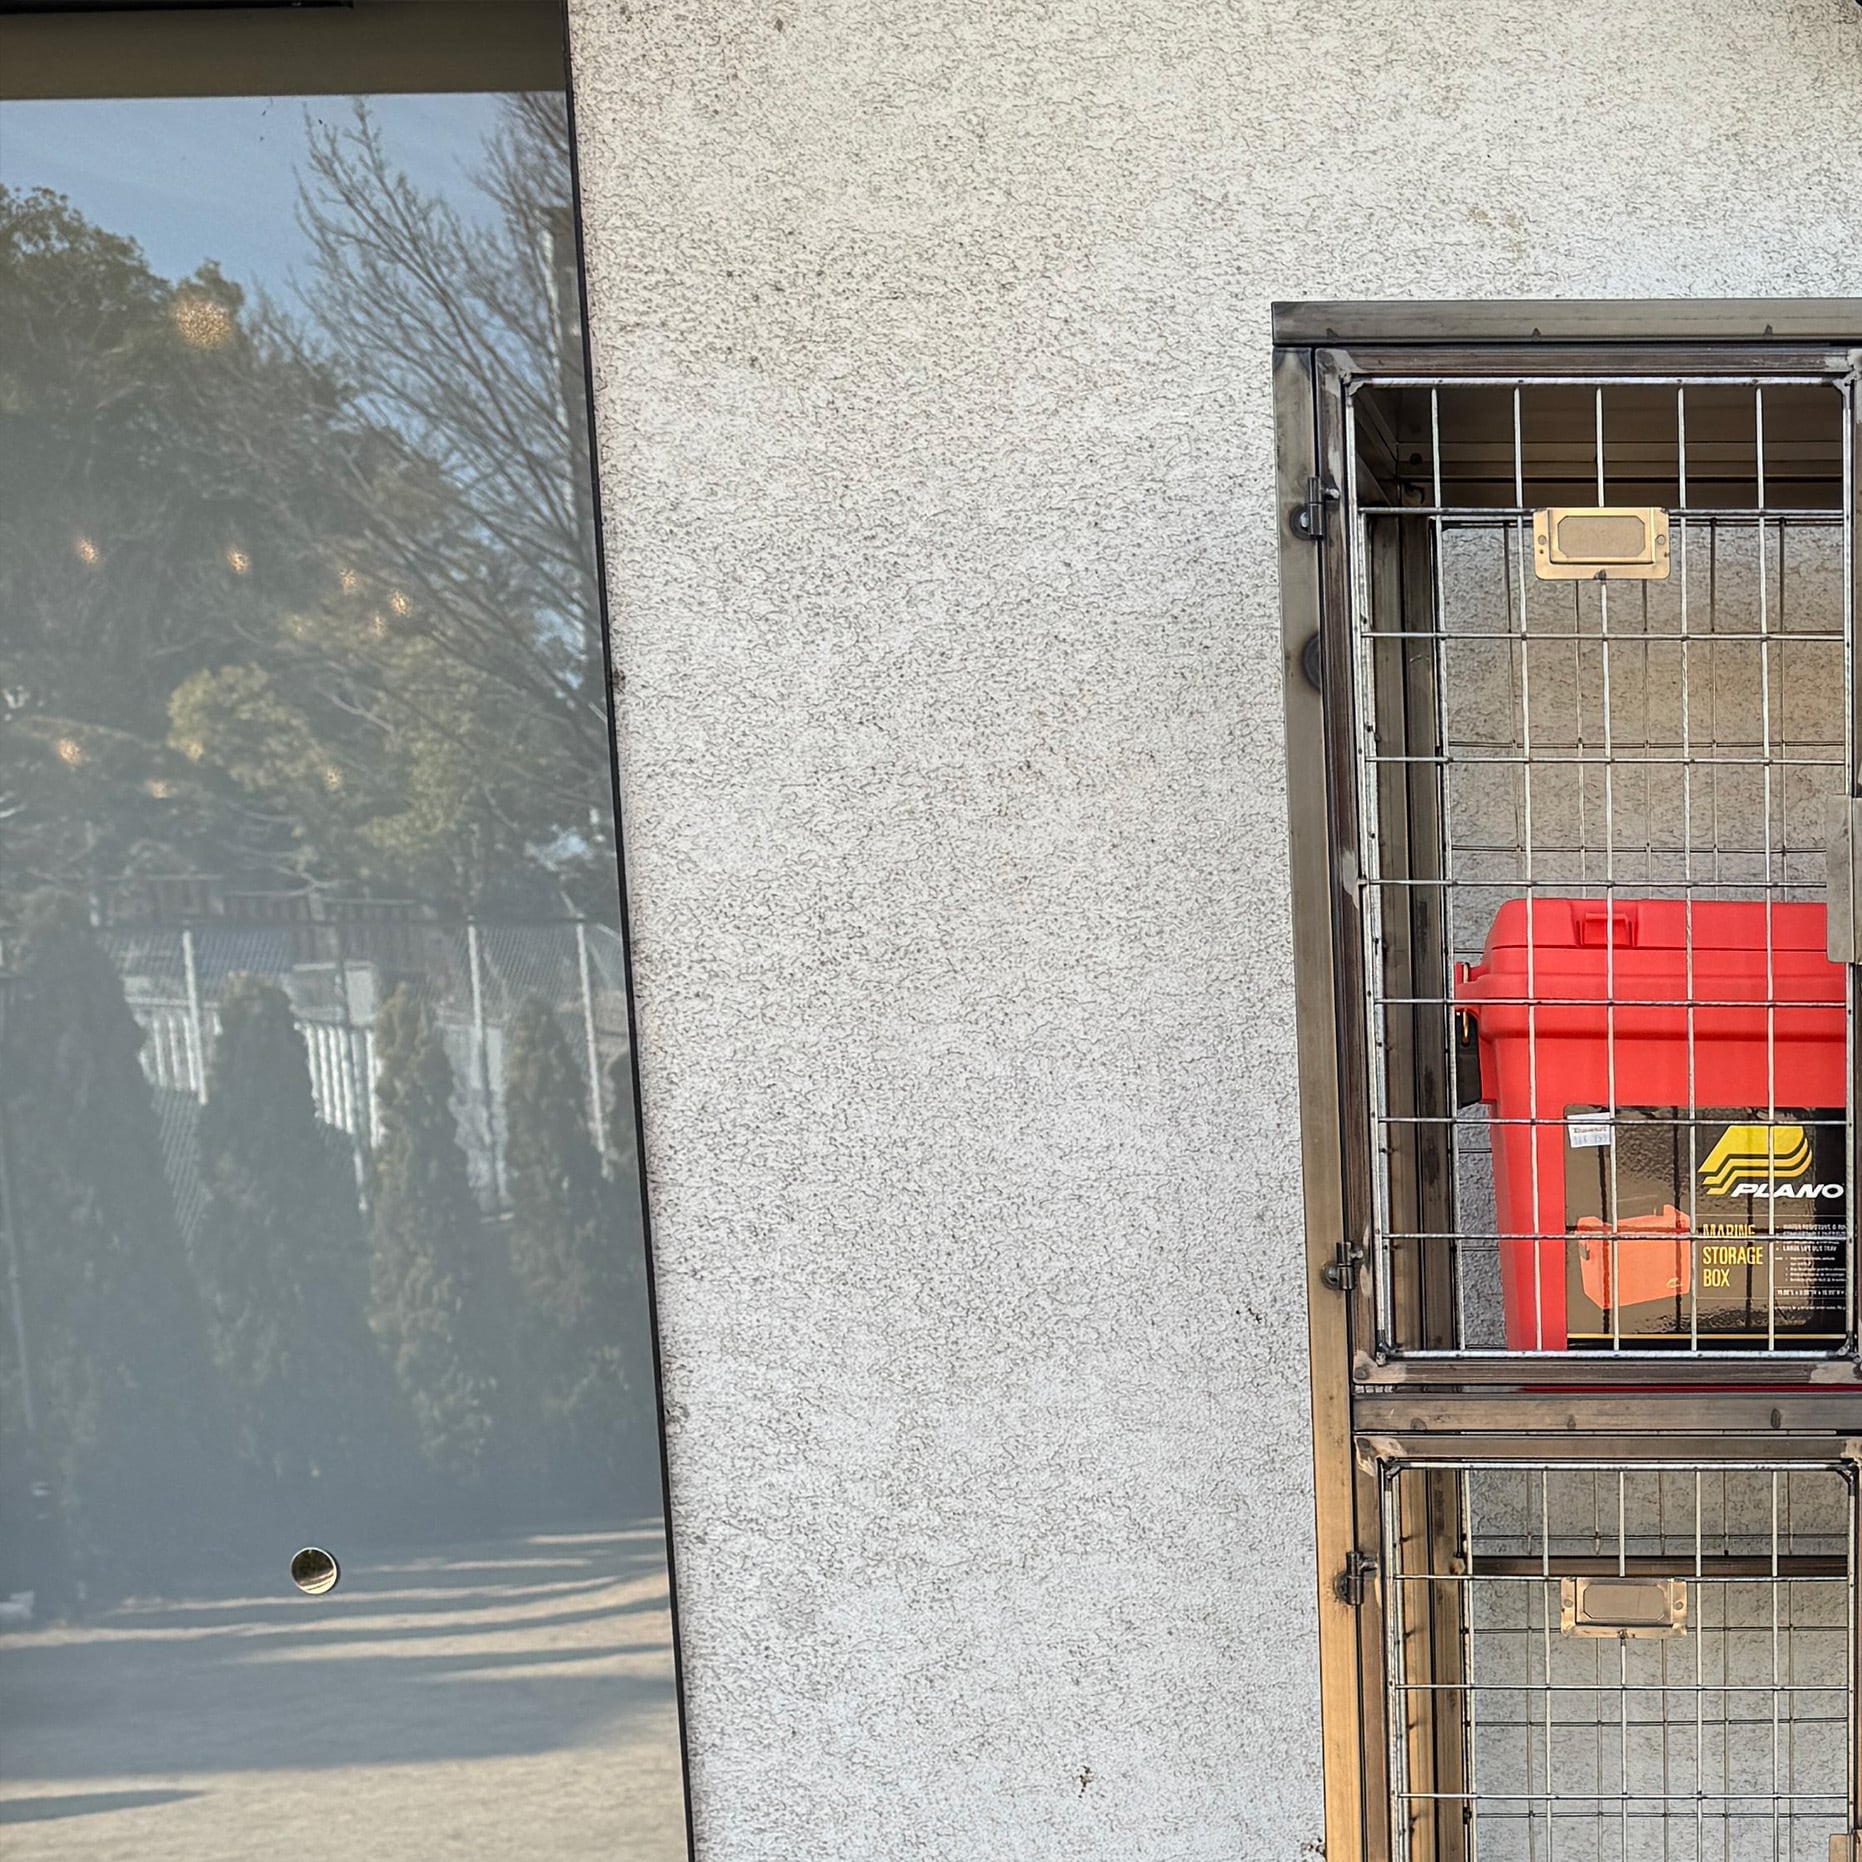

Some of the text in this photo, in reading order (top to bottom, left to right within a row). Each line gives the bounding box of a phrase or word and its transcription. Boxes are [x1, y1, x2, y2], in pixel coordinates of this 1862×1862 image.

[1730, 1183, 1845, 1199] PLANO
[1702, 1223, 1756, 1239] MARINE
[1702, 1246, 1764, 1265] STORAGE
[1703, 1268, 1731, 1287] BOX
